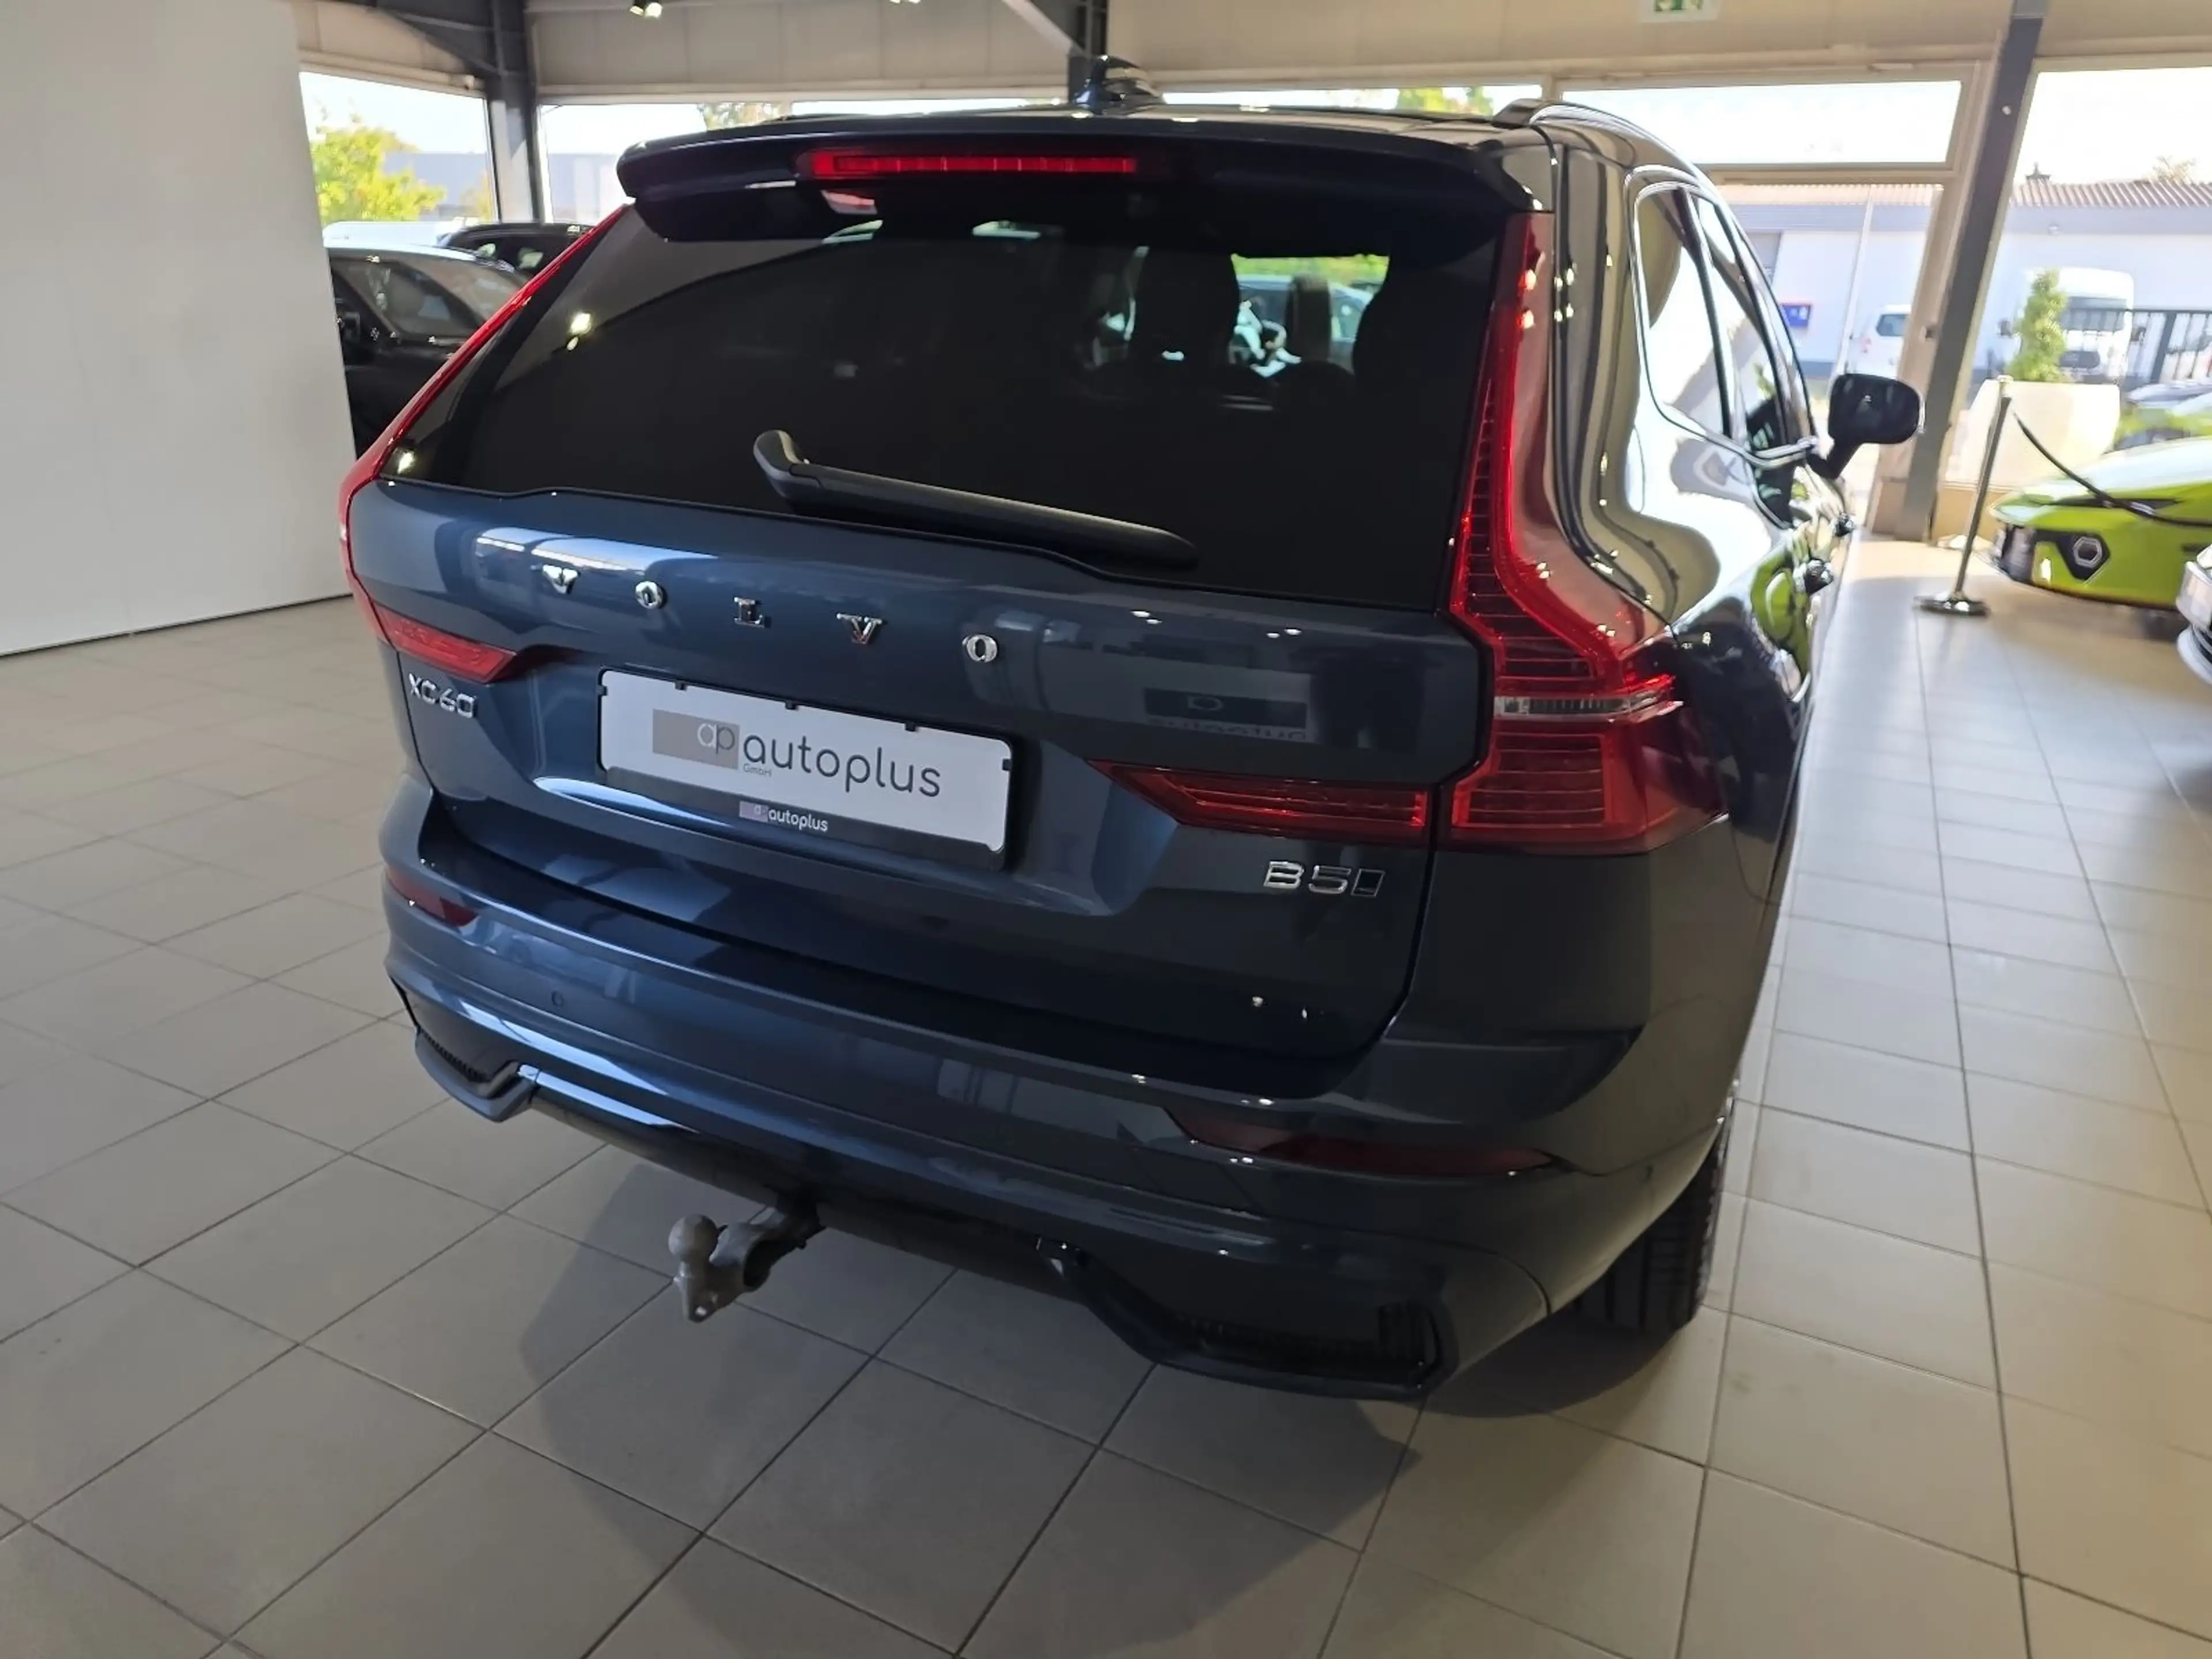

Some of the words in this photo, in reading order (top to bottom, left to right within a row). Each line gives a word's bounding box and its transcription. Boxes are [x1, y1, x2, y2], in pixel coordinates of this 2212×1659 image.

[541, 565, 998, 663] VOLVO
[408, 673, 475, 718] XC60
[743, 734, 941, 797] autoplus
[768, 809, 828, 832] autoplus
[1263, 861, 1352, 895] B5
